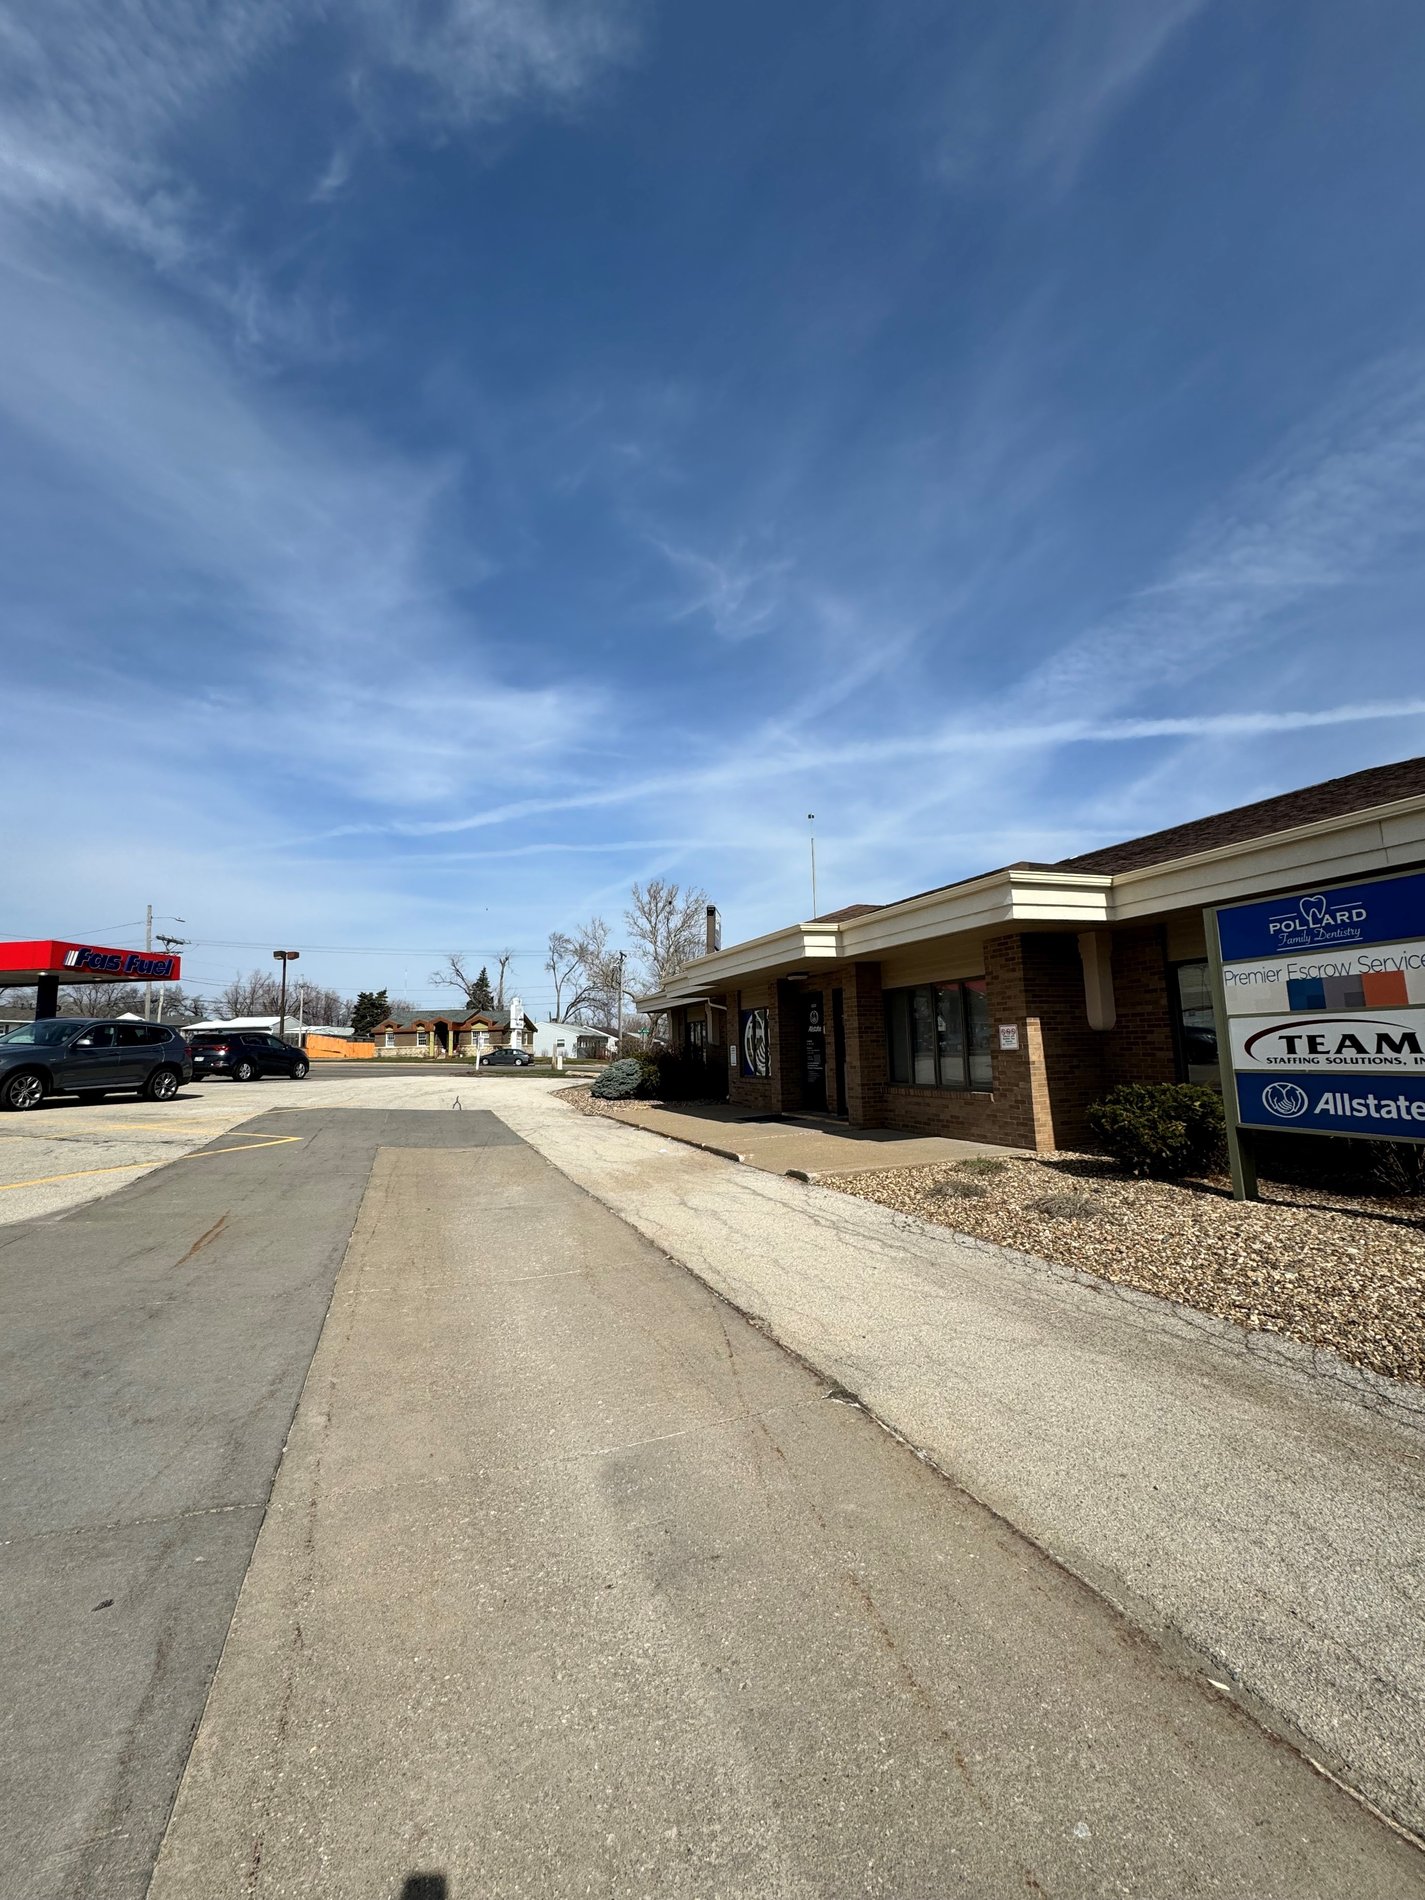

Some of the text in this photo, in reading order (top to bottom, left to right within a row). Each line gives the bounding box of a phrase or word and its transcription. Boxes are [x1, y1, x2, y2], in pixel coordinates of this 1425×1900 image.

[1269, 908, 1367, 934] POLLARD
[1278, 927, 1361, 946] Family Dentistry
[124, 956, 173, 975] Fuel
[1224, 966, 1283, 986] Premier
[1286, 962, 1351, 980] Escrow
[1278, 1032, 1424, 1055] TEAM
[1266, 1056, 1320, 1065] STAFFING
[1314, 1092, 1425, 1121] Allstate
